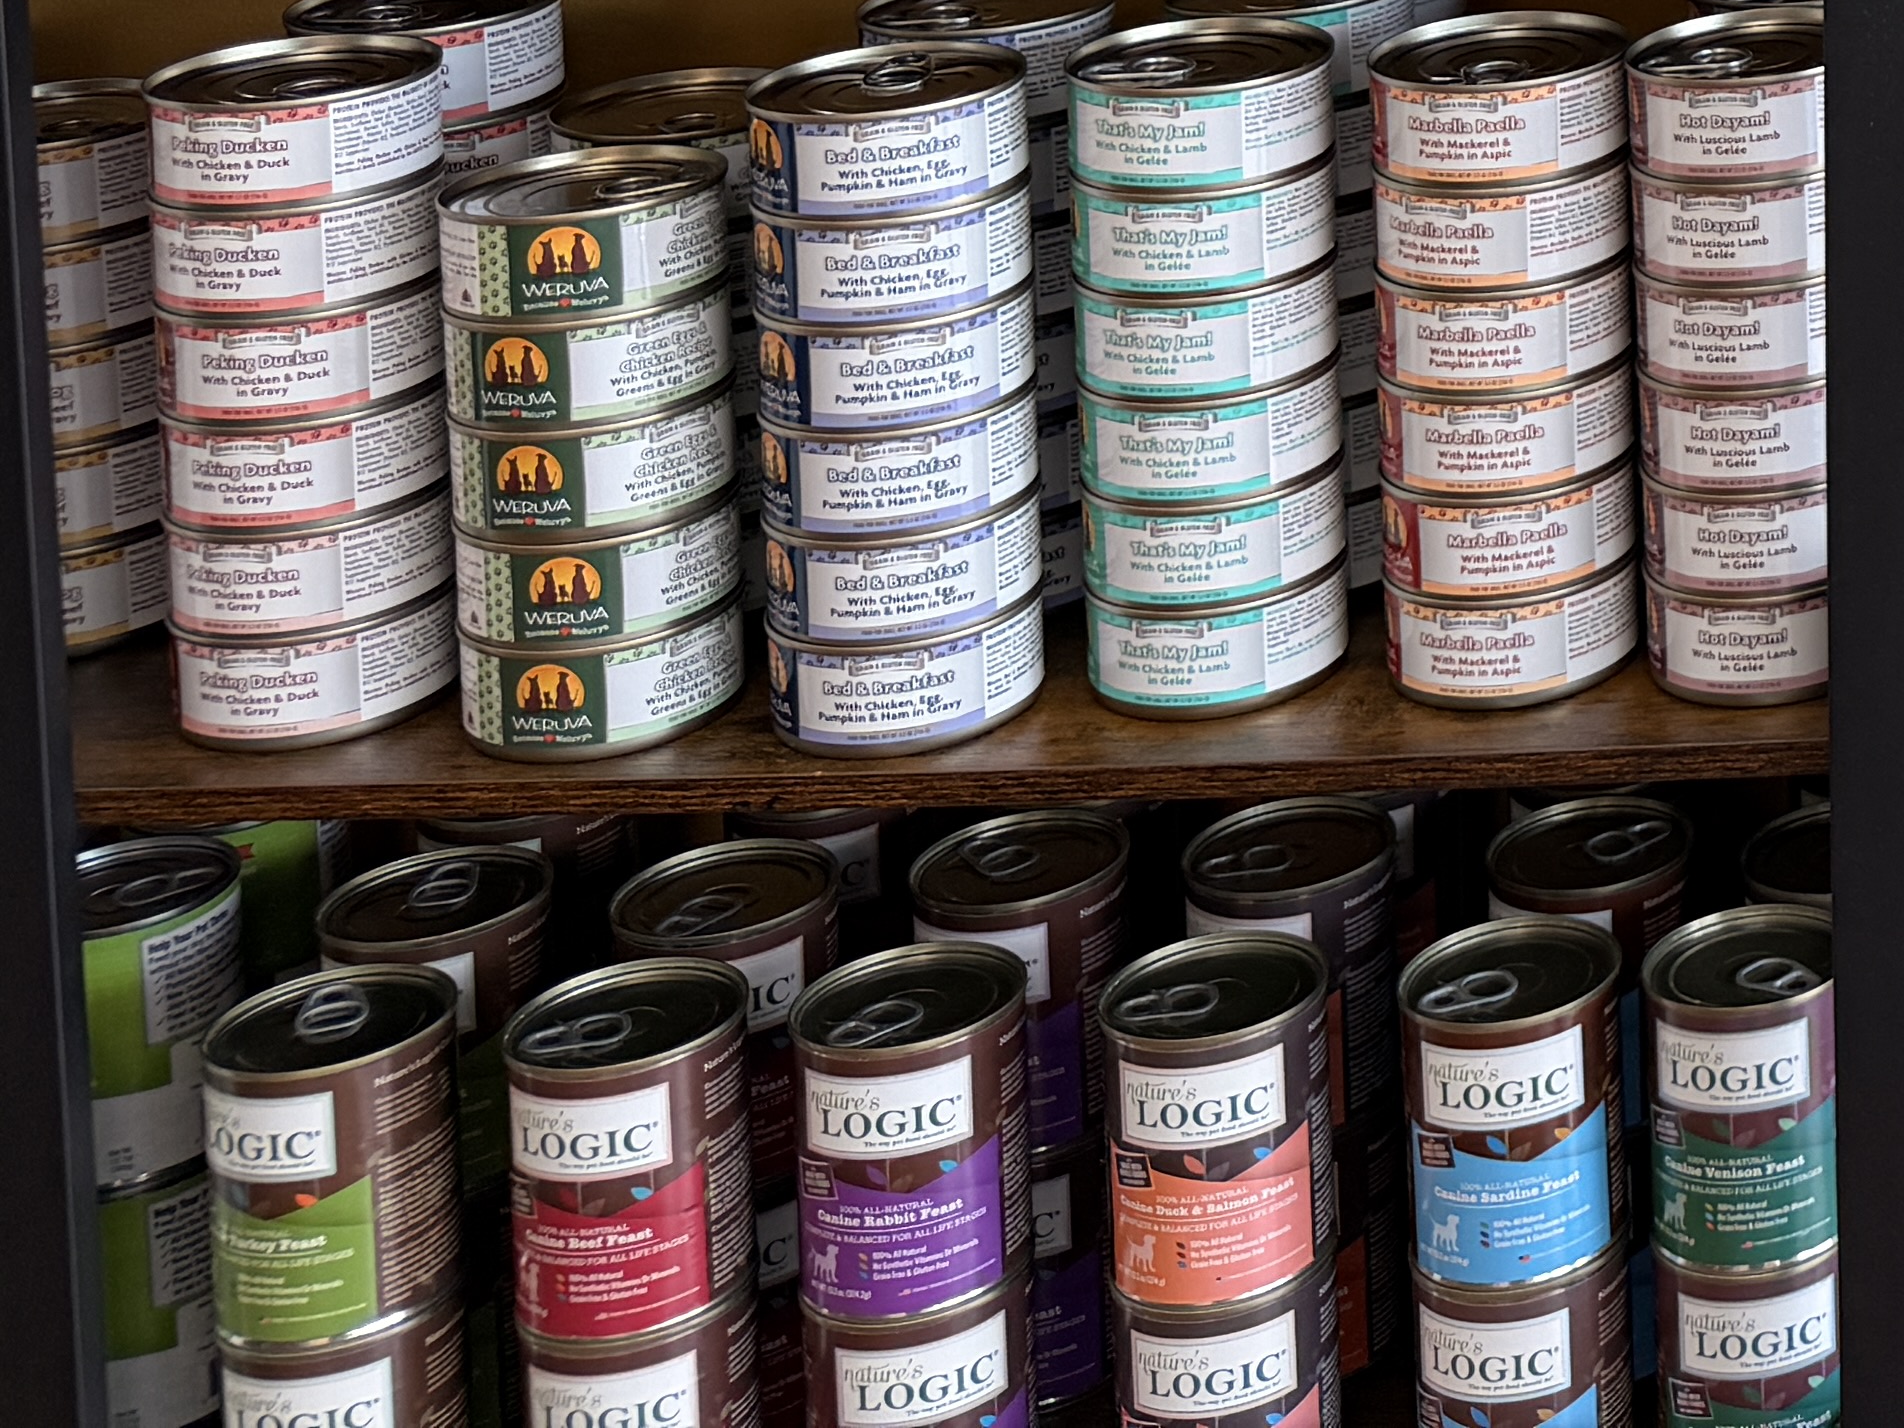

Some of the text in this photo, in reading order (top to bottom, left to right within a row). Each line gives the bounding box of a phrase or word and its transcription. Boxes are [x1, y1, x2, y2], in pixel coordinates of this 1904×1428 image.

[1096, 119, 1205, 142] That's My Jam!
[1680, 113, 1770, 129] Hot Dayam!
[201, 349, 328, 370] Peking Ducken
[818, 1196, 963, 1228] Canine Rabbit Feast
